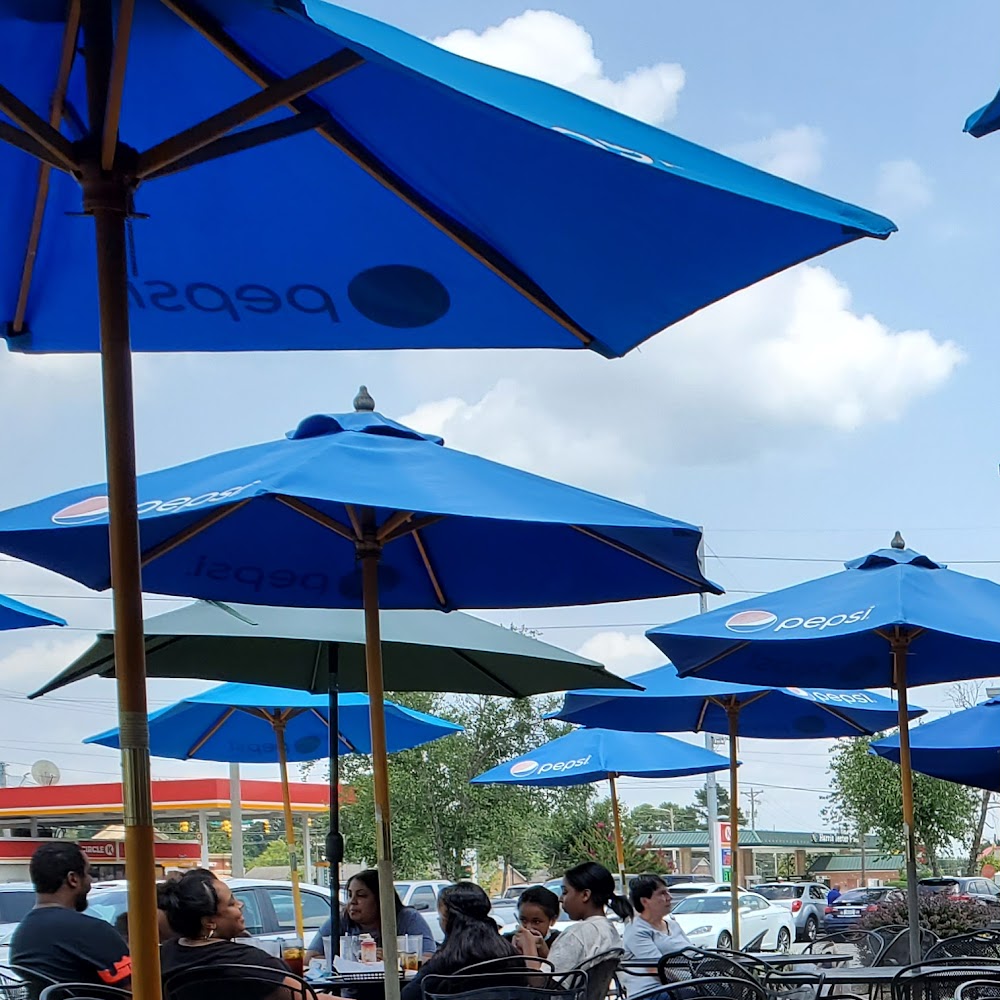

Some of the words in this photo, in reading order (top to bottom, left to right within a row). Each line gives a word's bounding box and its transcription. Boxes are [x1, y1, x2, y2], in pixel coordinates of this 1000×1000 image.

[773, 605, 876, 632] pepsi
[812, 691, 876, 705] pepsi
[537, 754, 592, 775] pepsi
